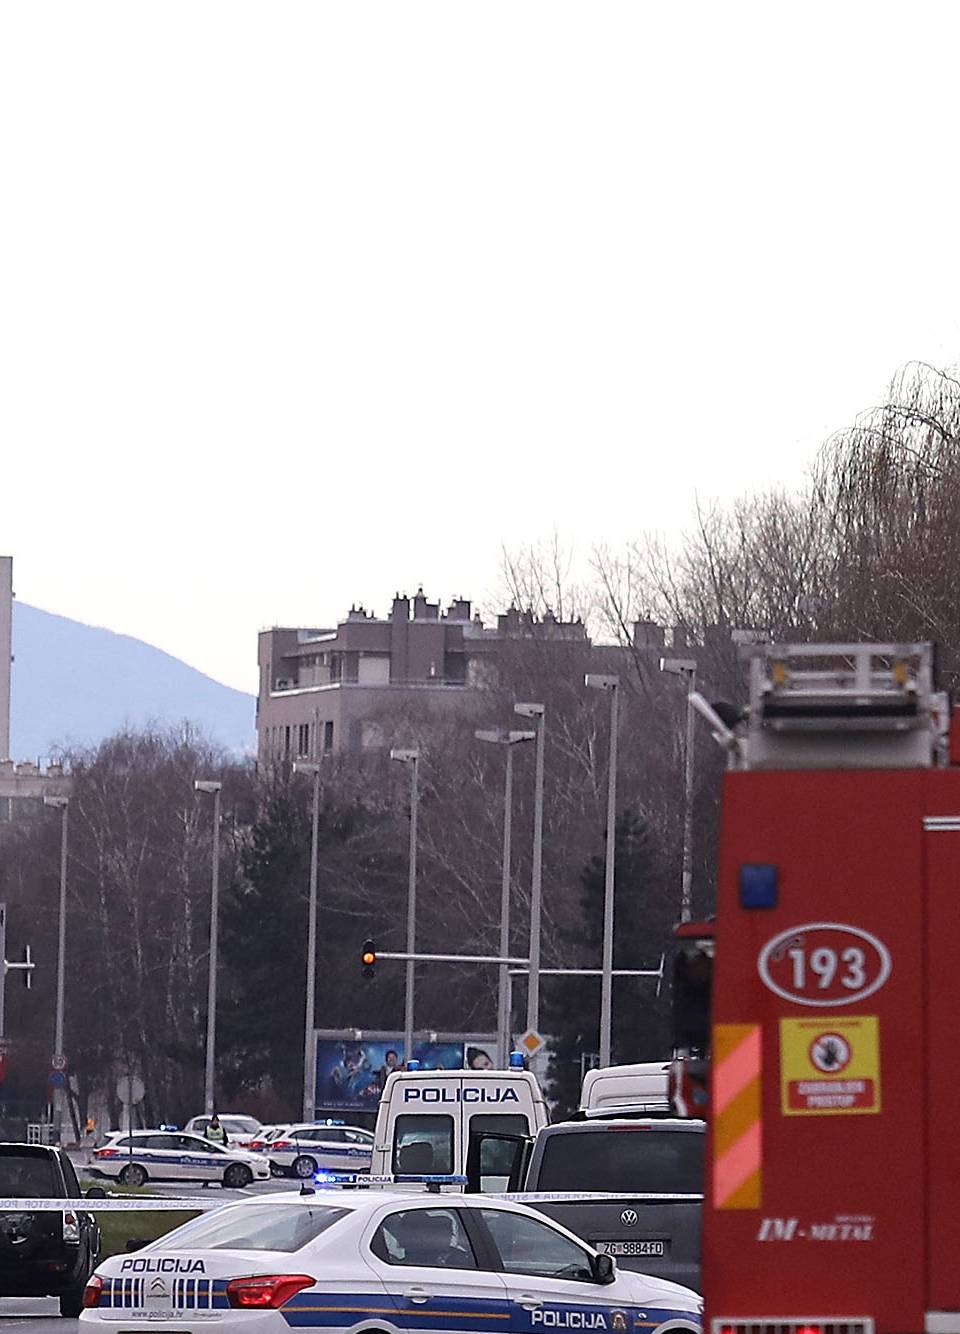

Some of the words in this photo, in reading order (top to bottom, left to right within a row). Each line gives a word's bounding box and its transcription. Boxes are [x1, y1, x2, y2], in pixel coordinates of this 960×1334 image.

[789, 947, 866, 990] 193
[404, 1088, 519, 1103] POLICIJA
[604, 1243, 616, 1254] ZG
[120, 1258, 206, 1274] POLICIJA
[531, 1310, 607, 1330] POLICIJA
